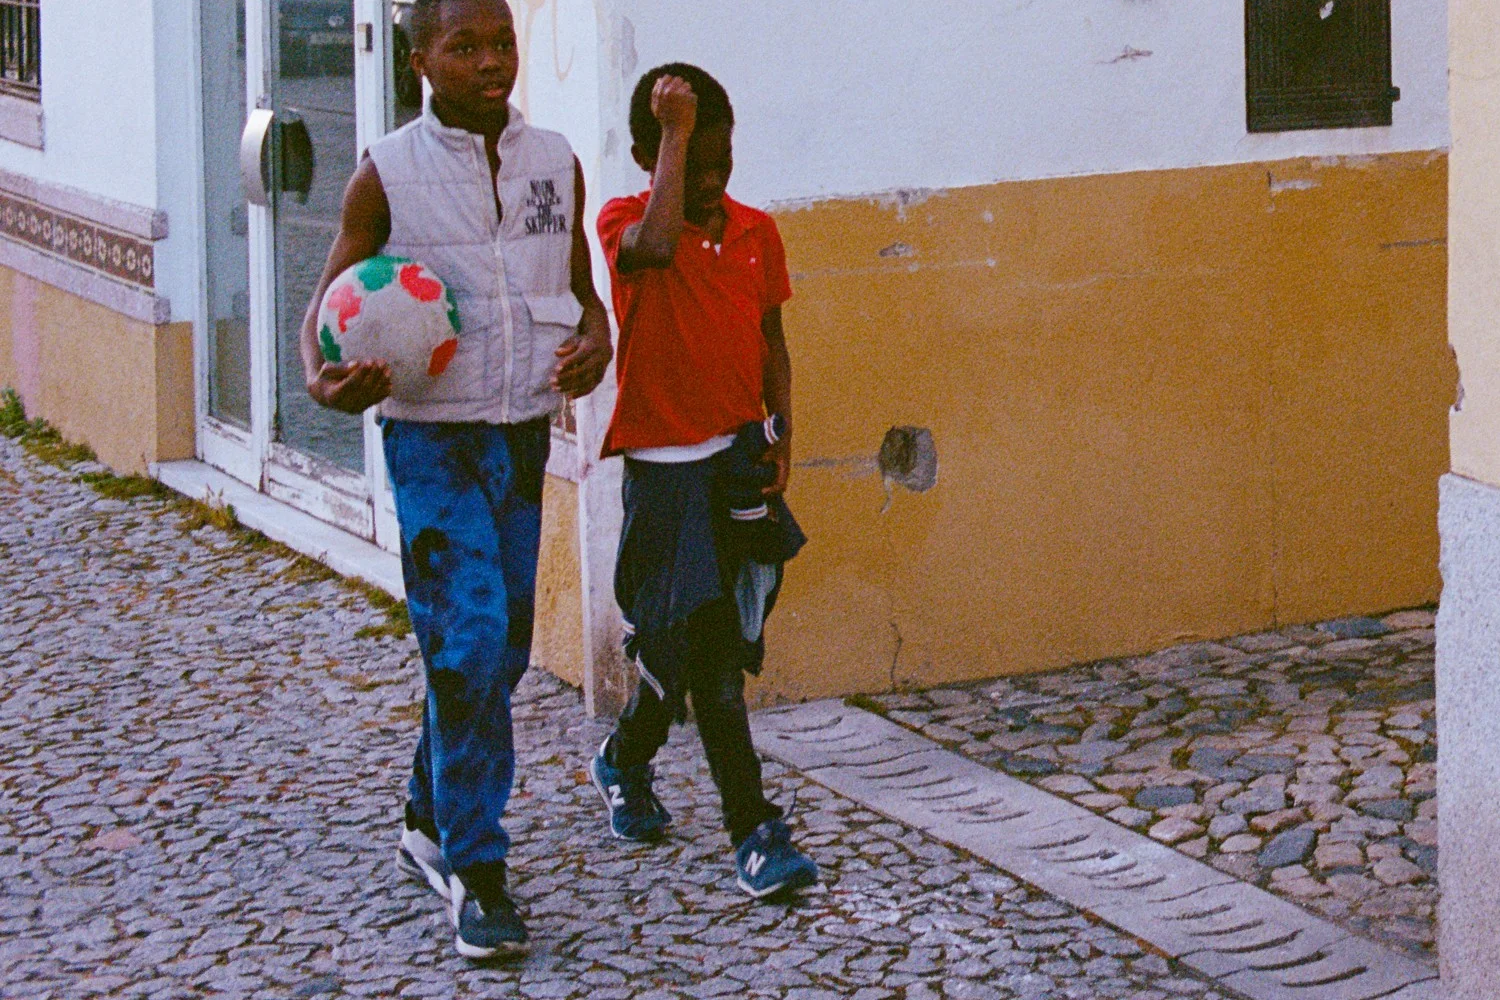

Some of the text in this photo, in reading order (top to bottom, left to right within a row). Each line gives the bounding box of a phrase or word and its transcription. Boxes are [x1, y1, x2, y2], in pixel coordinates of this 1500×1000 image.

[525, 213, 567, 235] SKIPPER
[608, 784, 625, 806] N
[745, 851, 766, 876] N
